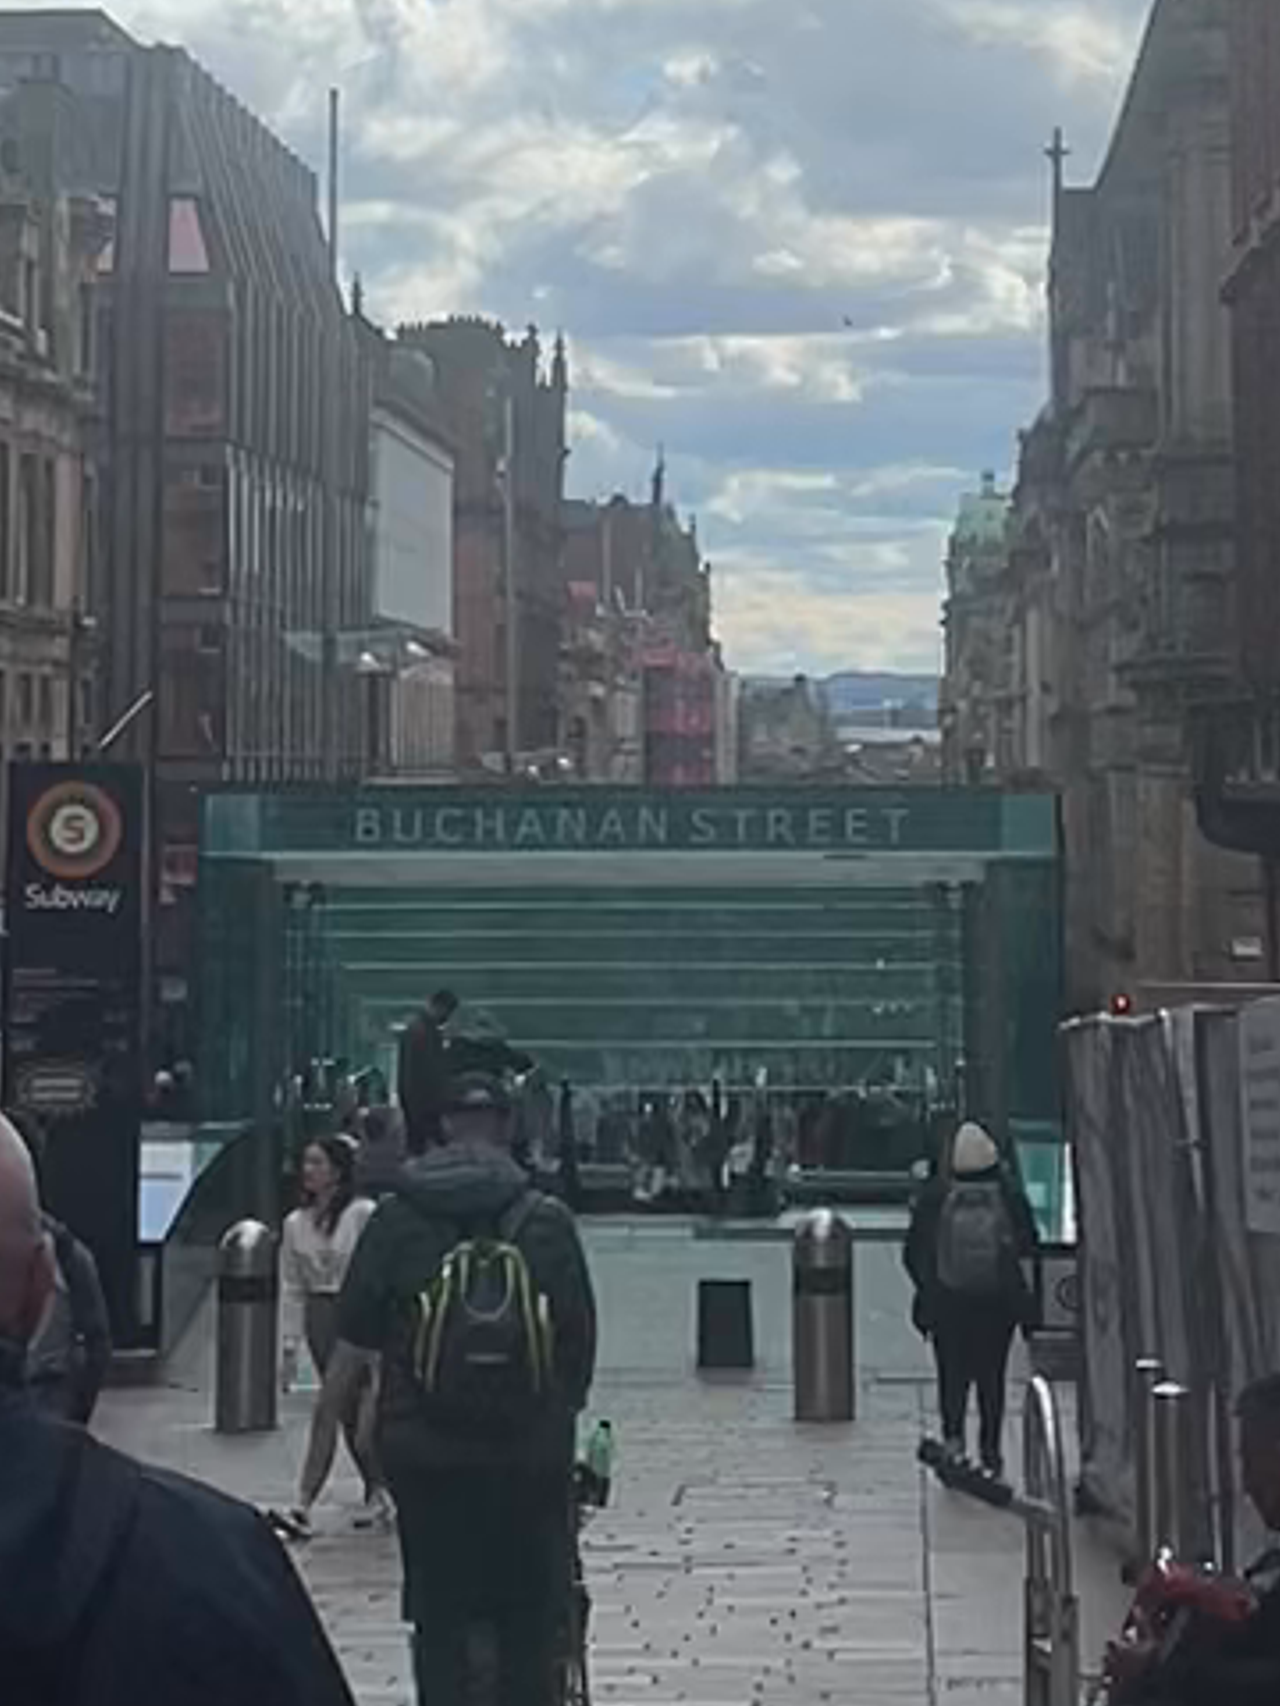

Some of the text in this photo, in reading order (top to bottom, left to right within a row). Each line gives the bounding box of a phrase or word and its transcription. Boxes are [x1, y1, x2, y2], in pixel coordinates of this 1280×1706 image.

[356, 807, 910, 843] BUCHANAN STREET
[25, 883, 121, 912] Subway
